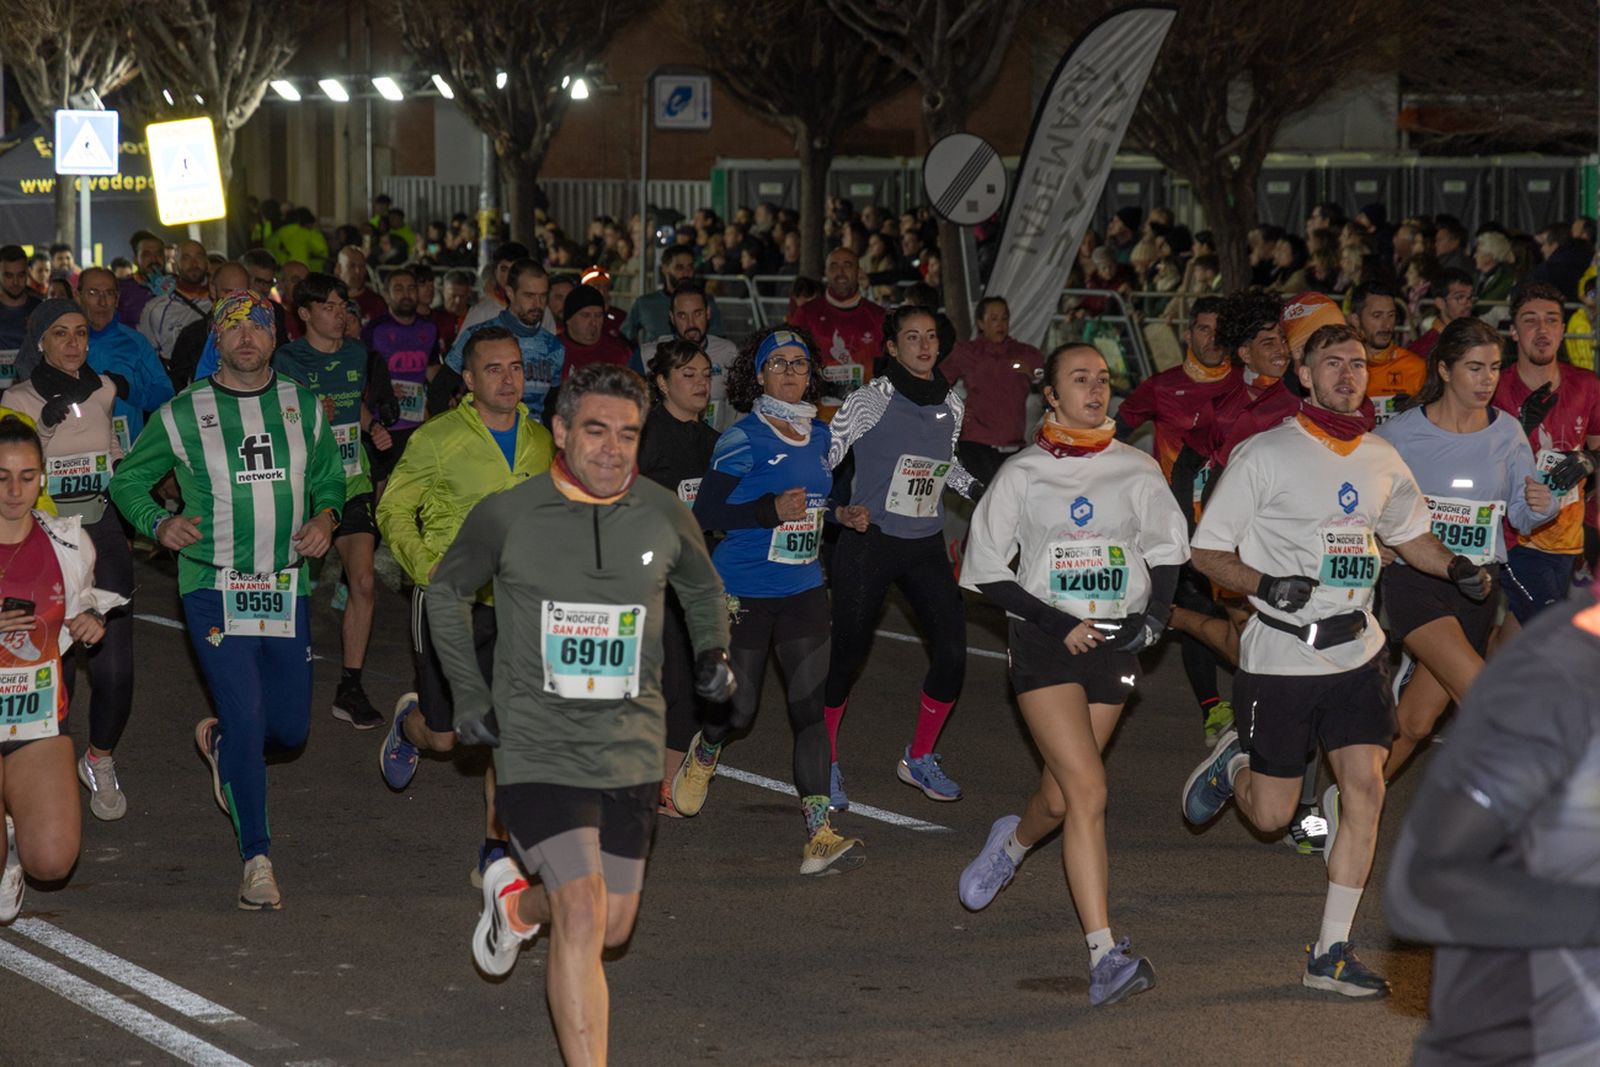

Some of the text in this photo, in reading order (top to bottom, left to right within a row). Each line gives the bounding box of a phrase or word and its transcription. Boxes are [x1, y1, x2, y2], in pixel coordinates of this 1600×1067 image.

[240, 434, 273, 471] fi
[238, 470, 284, 482] network
[61, 474, 103, 494] 6794
[1436, 504, 1460, 514] NOCHE
[1461, 508, 1471, 516] DE
[1431, 512, 1443, 520] AN
[780, 523, 794, 532] SAN
[1336, 536, 1356, 545] NOCHE
[1357, 536, 1364, 545] DE
[1432, 522, 1488, 548] 3959
[1092, 548, 1102, 557] DE
[1328, 545, 1342, 554] SAN
[1055, 560, 1073, 569] SAN
[1329, 555, 1375, 580] 13475
[1057, 567, 1124, 592] 12060
[230, 582, 245, 590] SAN
[235, 591, 284, 613] 9559
[566, 614, 595, 625] NOCHE
[598, 616, 609, 625] DE
[552, 624, 575, 635] SAN
[560, 637, 625, 668] 6910
[19, 674, 29, 683] DE
